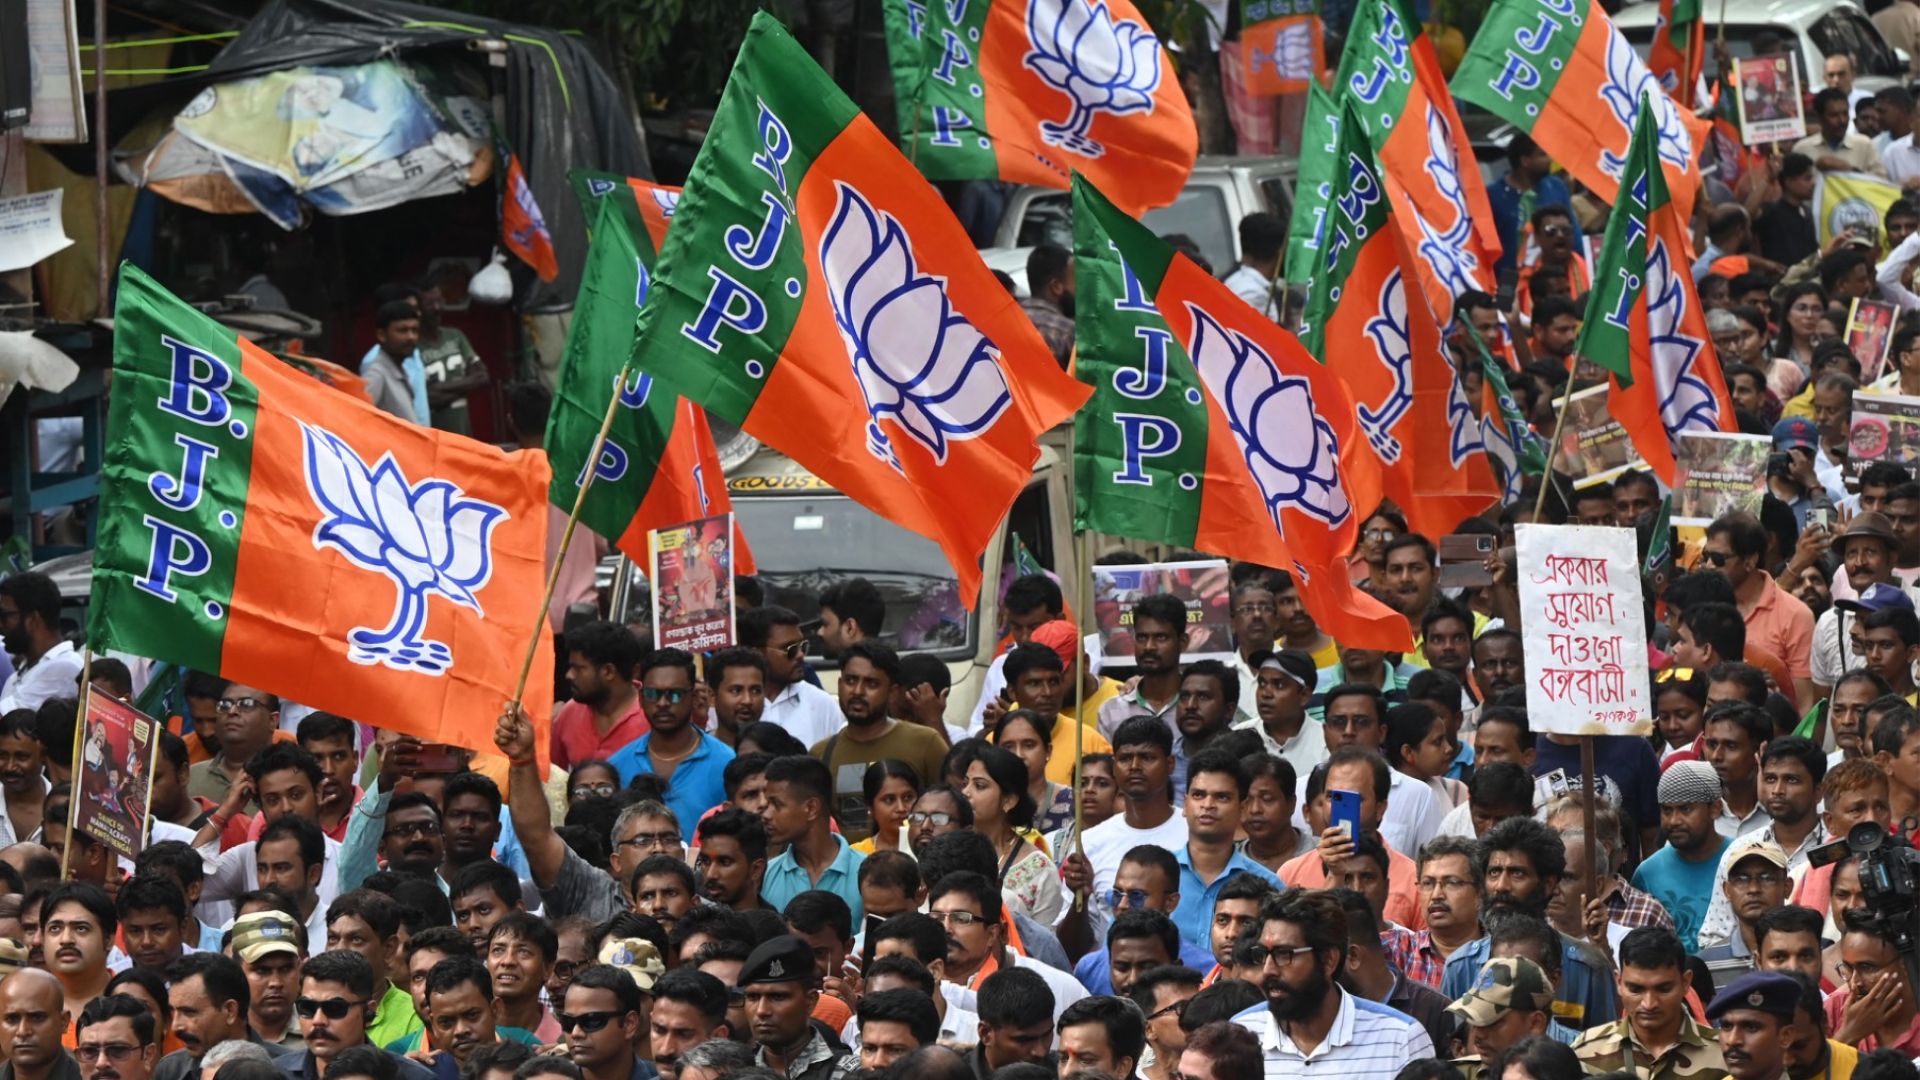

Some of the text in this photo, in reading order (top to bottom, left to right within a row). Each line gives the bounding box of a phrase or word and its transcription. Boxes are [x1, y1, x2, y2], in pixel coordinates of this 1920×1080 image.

[681, 265, 768, 378] P.
[133, 334, 248, 620] B. J. P.
[1113, 412, 1197, 490] P.
[1532, 554, 1608, 586] একবার
[1548, 633, 1623, 666] দাওগো
